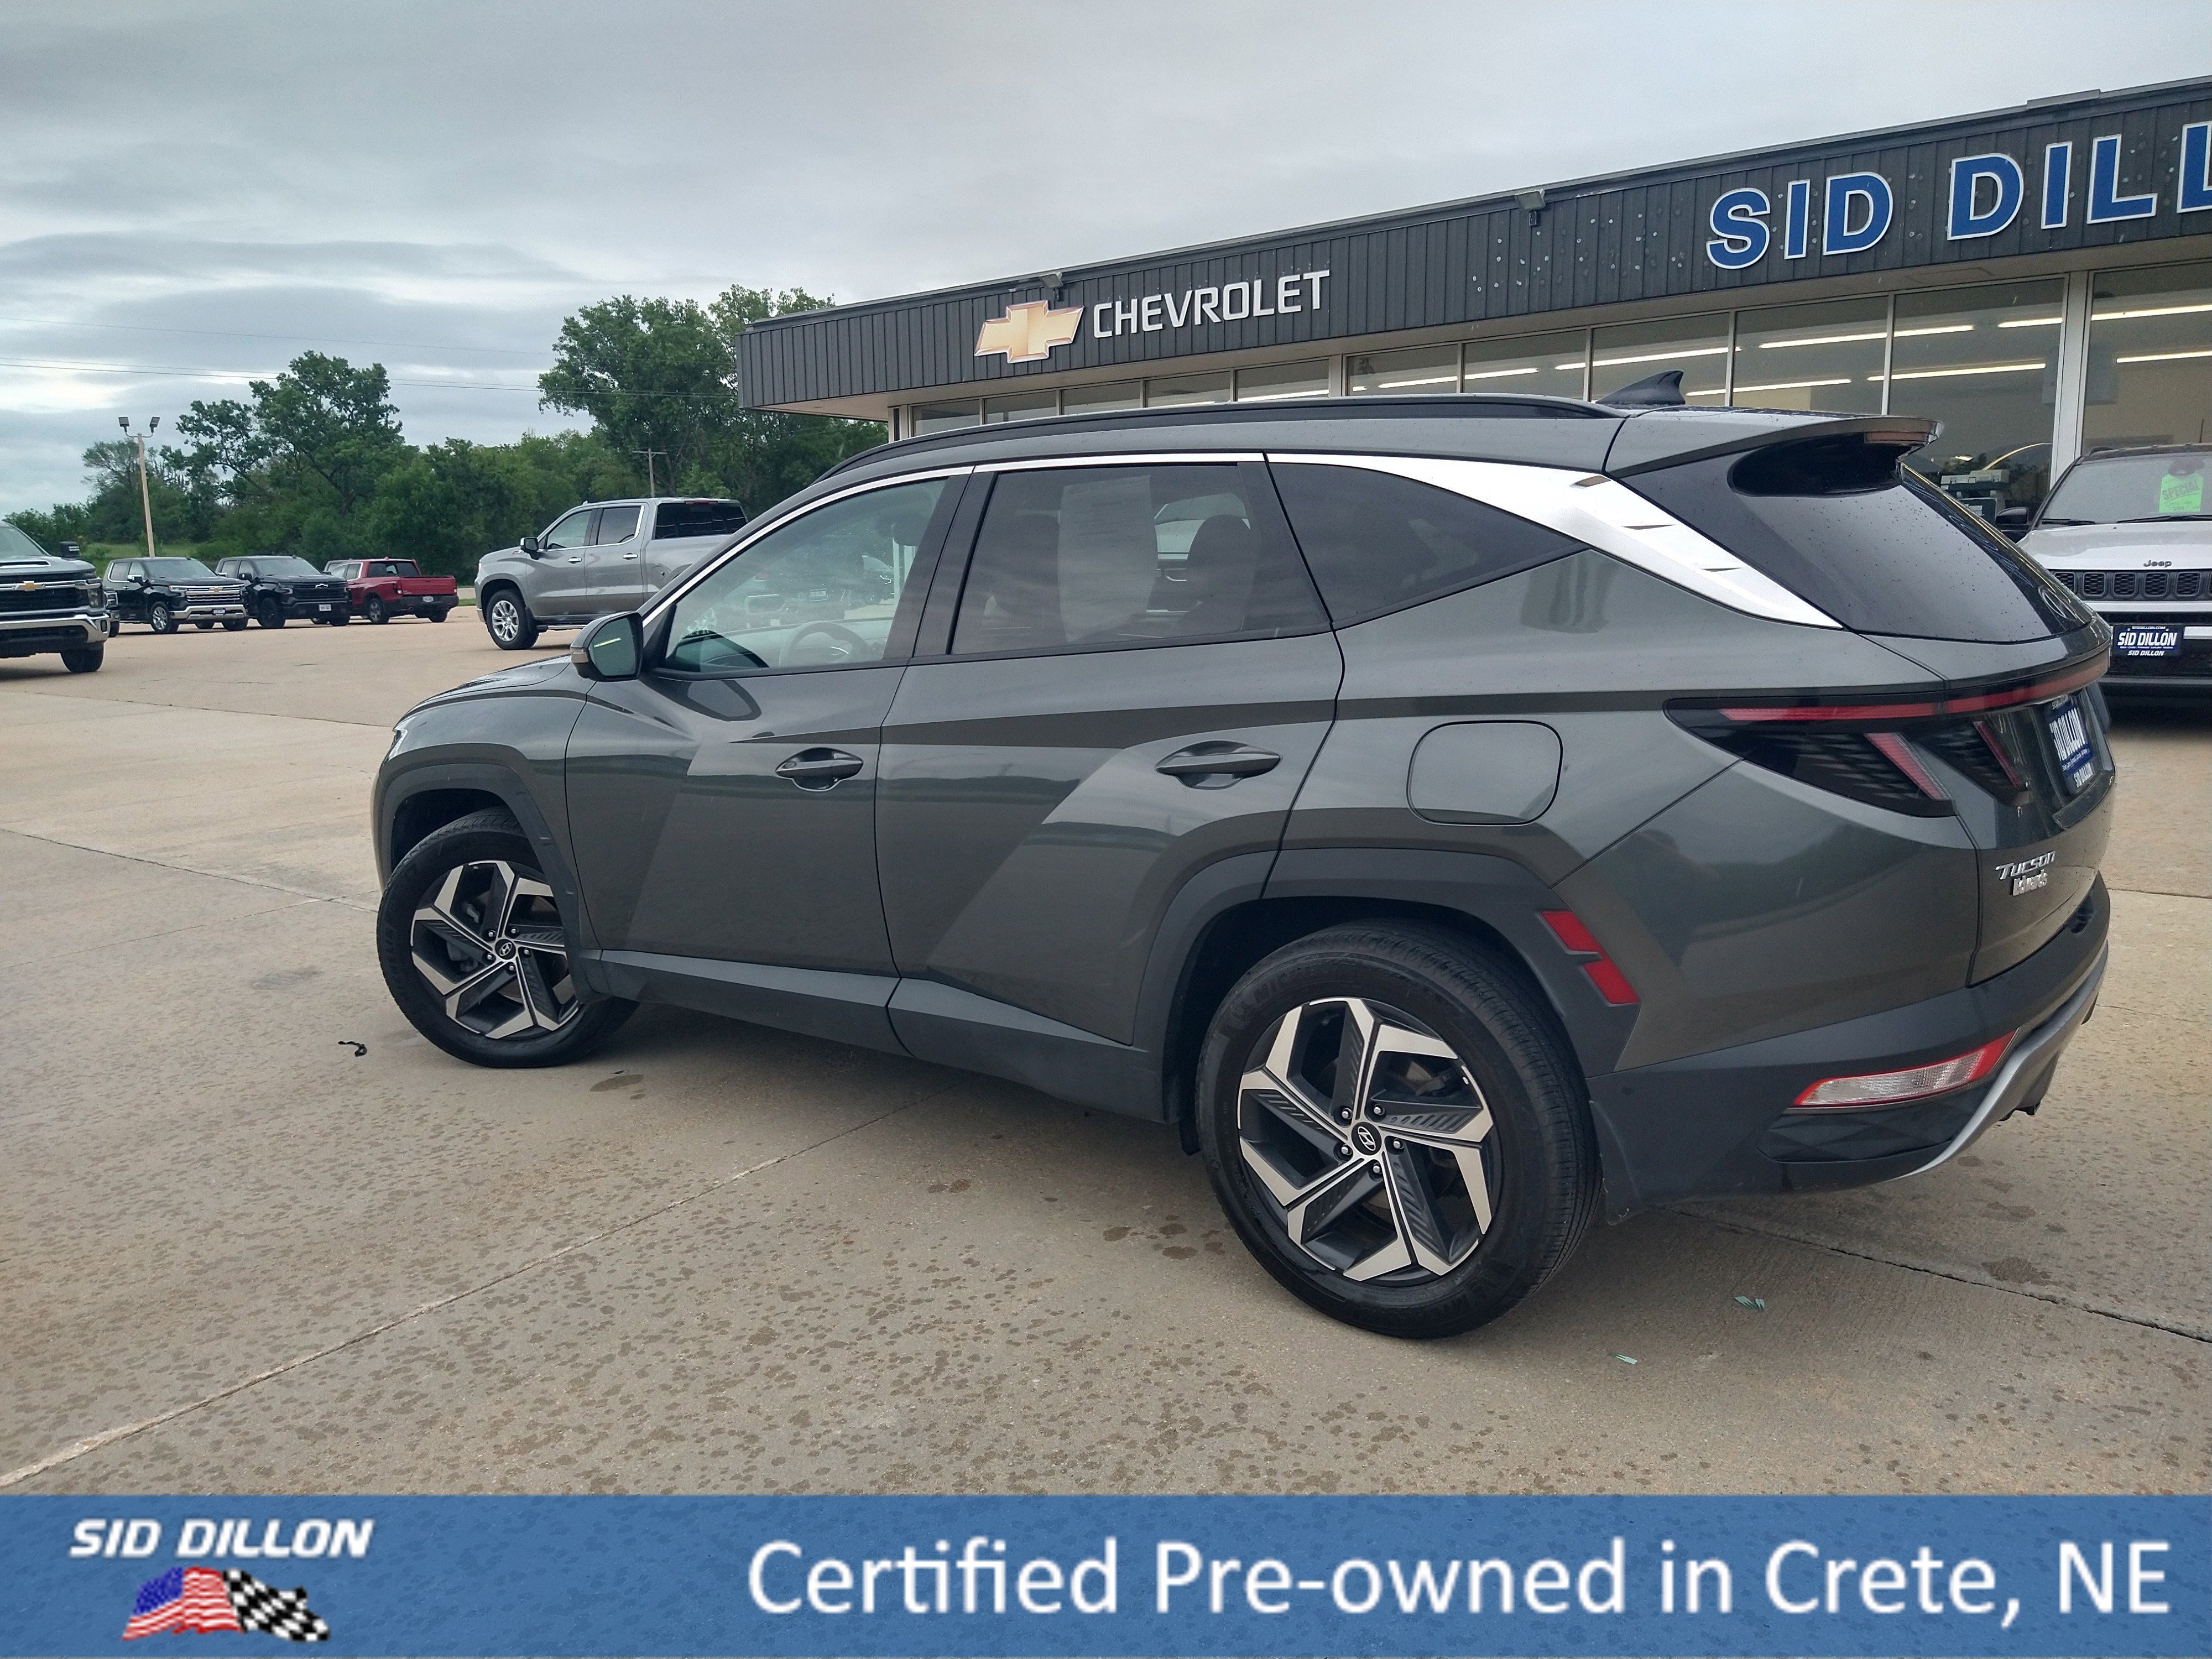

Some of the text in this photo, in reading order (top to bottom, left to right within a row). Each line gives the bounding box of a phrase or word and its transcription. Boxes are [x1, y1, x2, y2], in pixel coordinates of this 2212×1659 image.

[1705, 171, 1893, 270] SID
[1093, 269, 1331, 339] CHEVROLET
[2162, 480, 2200, 500] SPECIAL
[2143, 560, 2172, 568] Jeep
[2117, 632, 2178, 646] SID DILLON
[2057, 707, 2088, 757] DILLON
[1995, 851, 2056, 880] Tucson
